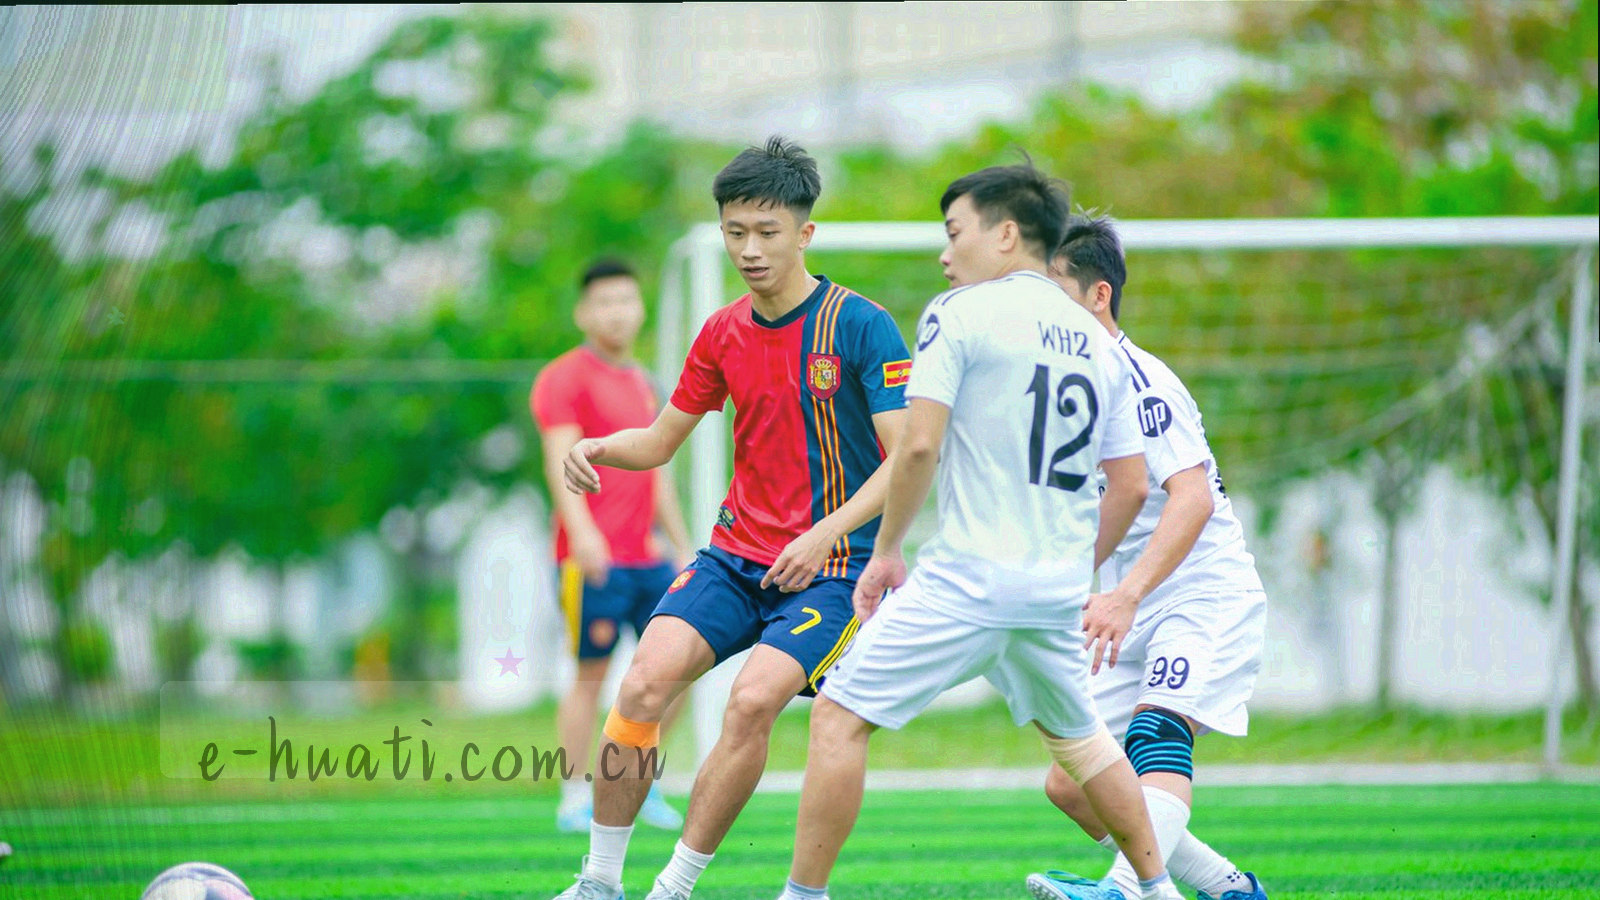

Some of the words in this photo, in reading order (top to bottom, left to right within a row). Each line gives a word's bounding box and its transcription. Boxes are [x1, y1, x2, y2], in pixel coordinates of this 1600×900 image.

[1037, 321, 1091, 360] WH2
[1025, 363, 1099, 492] 12
[1139, 397, 1169, 437] hp
[790, 606, 822, 636] 7
[1148, 656, 1190, 690] 99
